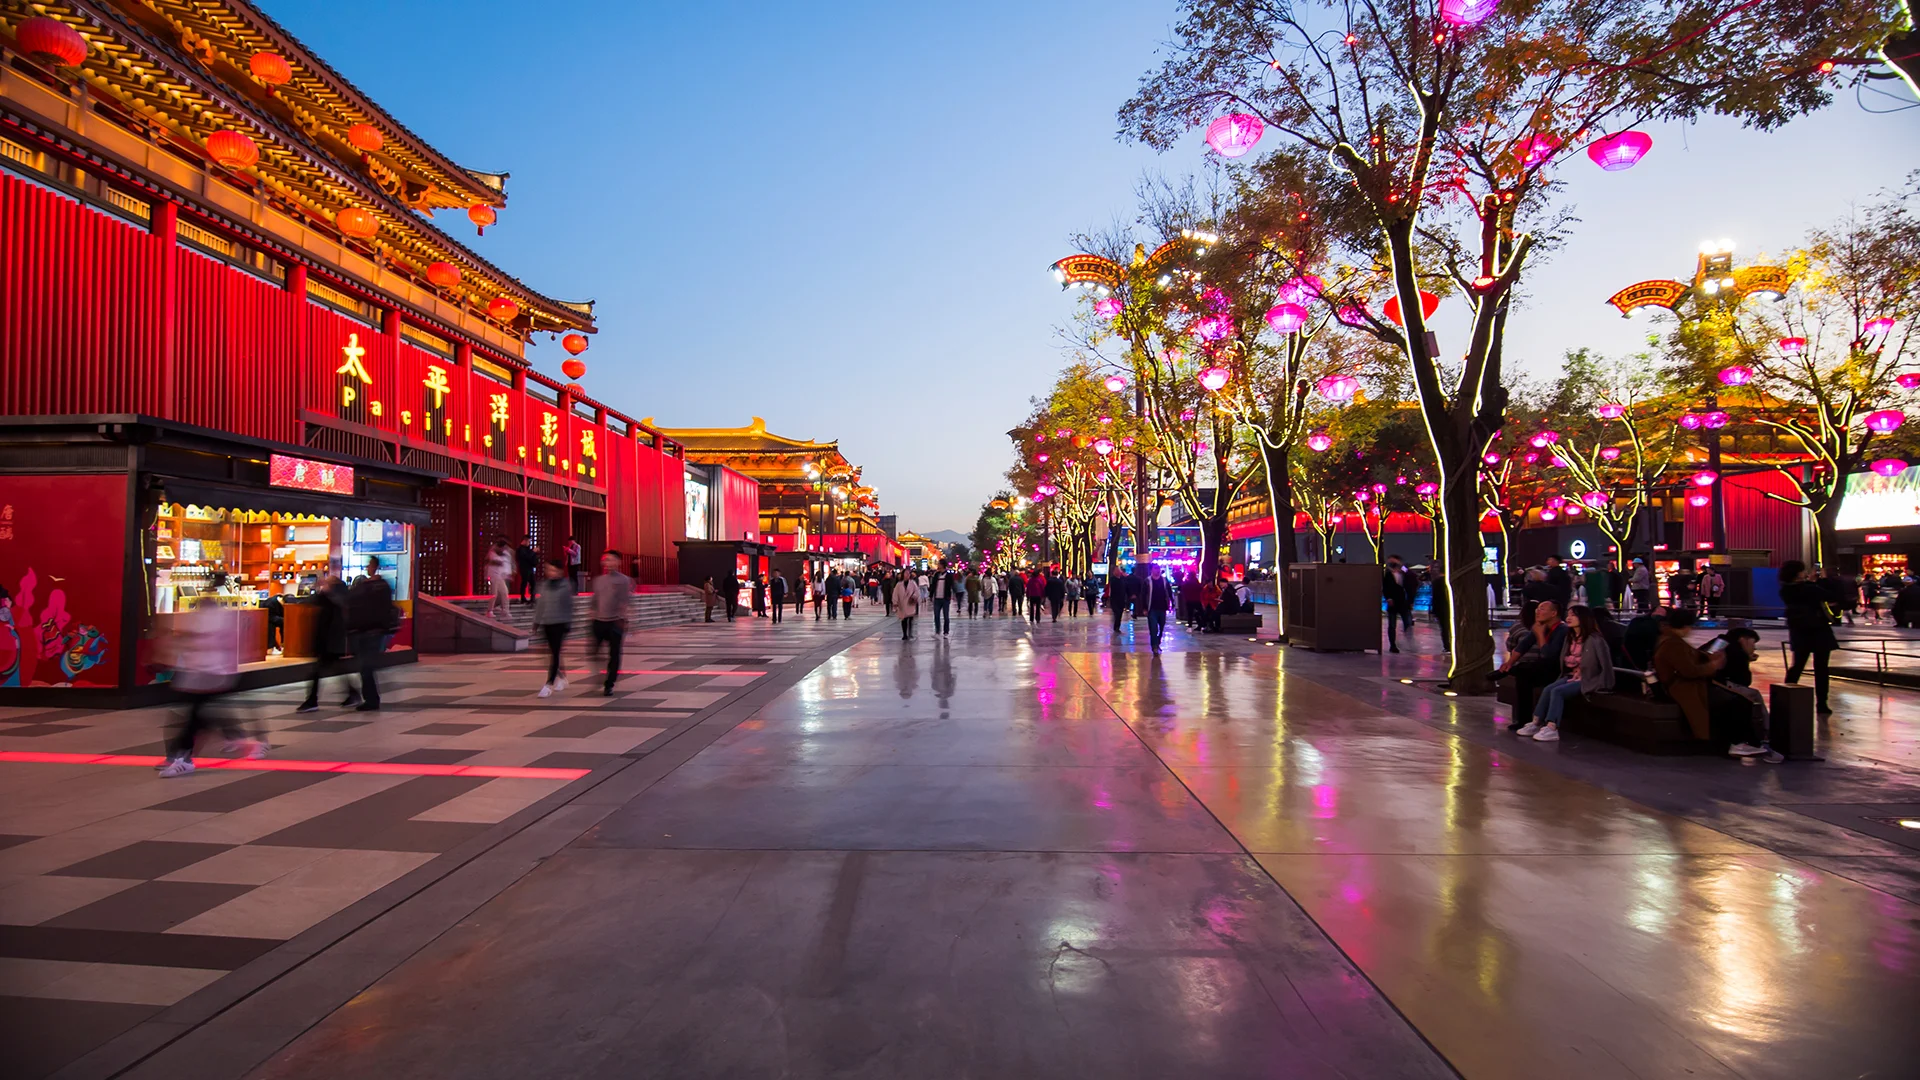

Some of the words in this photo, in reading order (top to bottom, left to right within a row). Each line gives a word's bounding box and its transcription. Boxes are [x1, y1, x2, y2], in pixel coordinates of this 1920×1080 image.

[336, 333, 597, 461] 太平洋影城
[343, 385, 493, 447] Pacific
[518, 446, 597, 478] cinema
